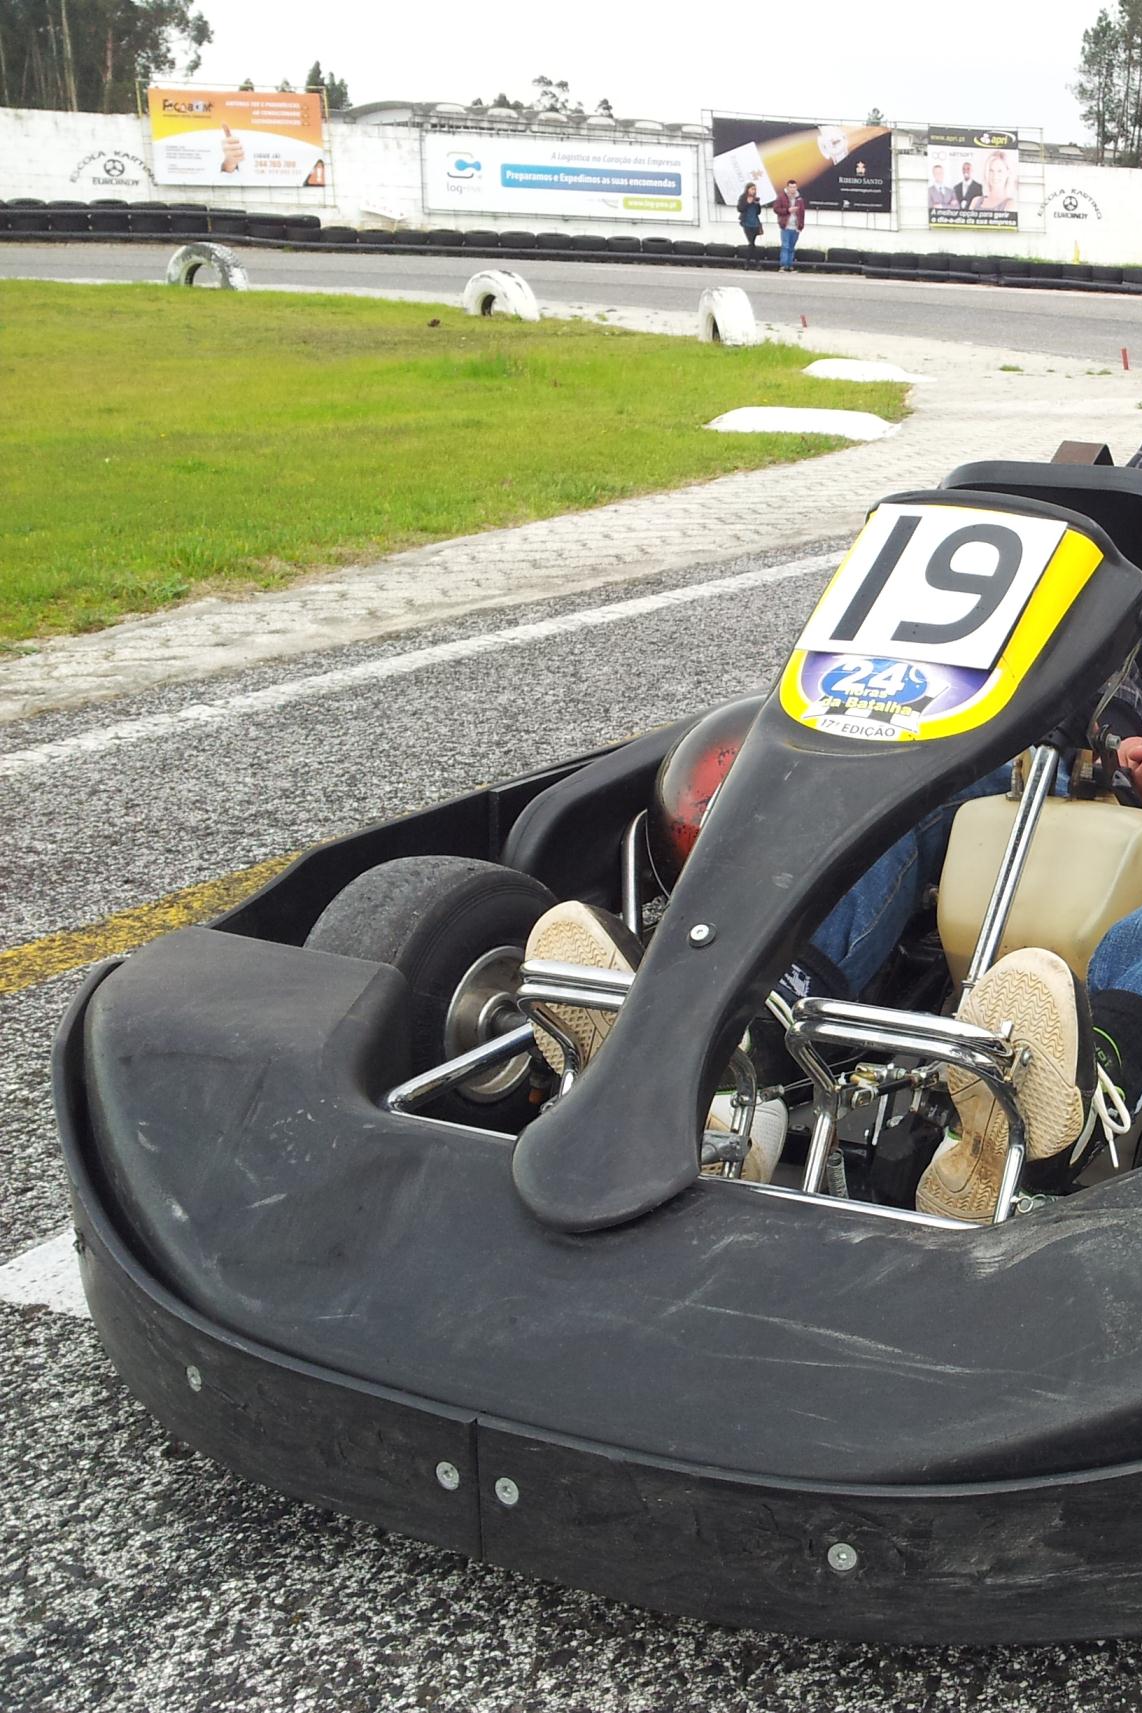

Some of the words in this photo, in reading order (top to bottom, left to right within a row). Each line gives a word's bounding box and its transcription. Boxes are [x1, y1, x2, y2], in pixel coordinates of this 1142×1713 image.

[505, 169, 553, 182] Preparamos
[559, 172, 601, 185] Expedimos
[610, 177, 629, 186] suas
[629, 178, 677, 188] encomendas
[829, 515, 1023, 645] 19
[829, 656, 909, 696] 24
[821, 695, 842, 708] da
[845, 696, 914, 717] Batalha
[841, 722, 896, 738] EDIÇÃO
